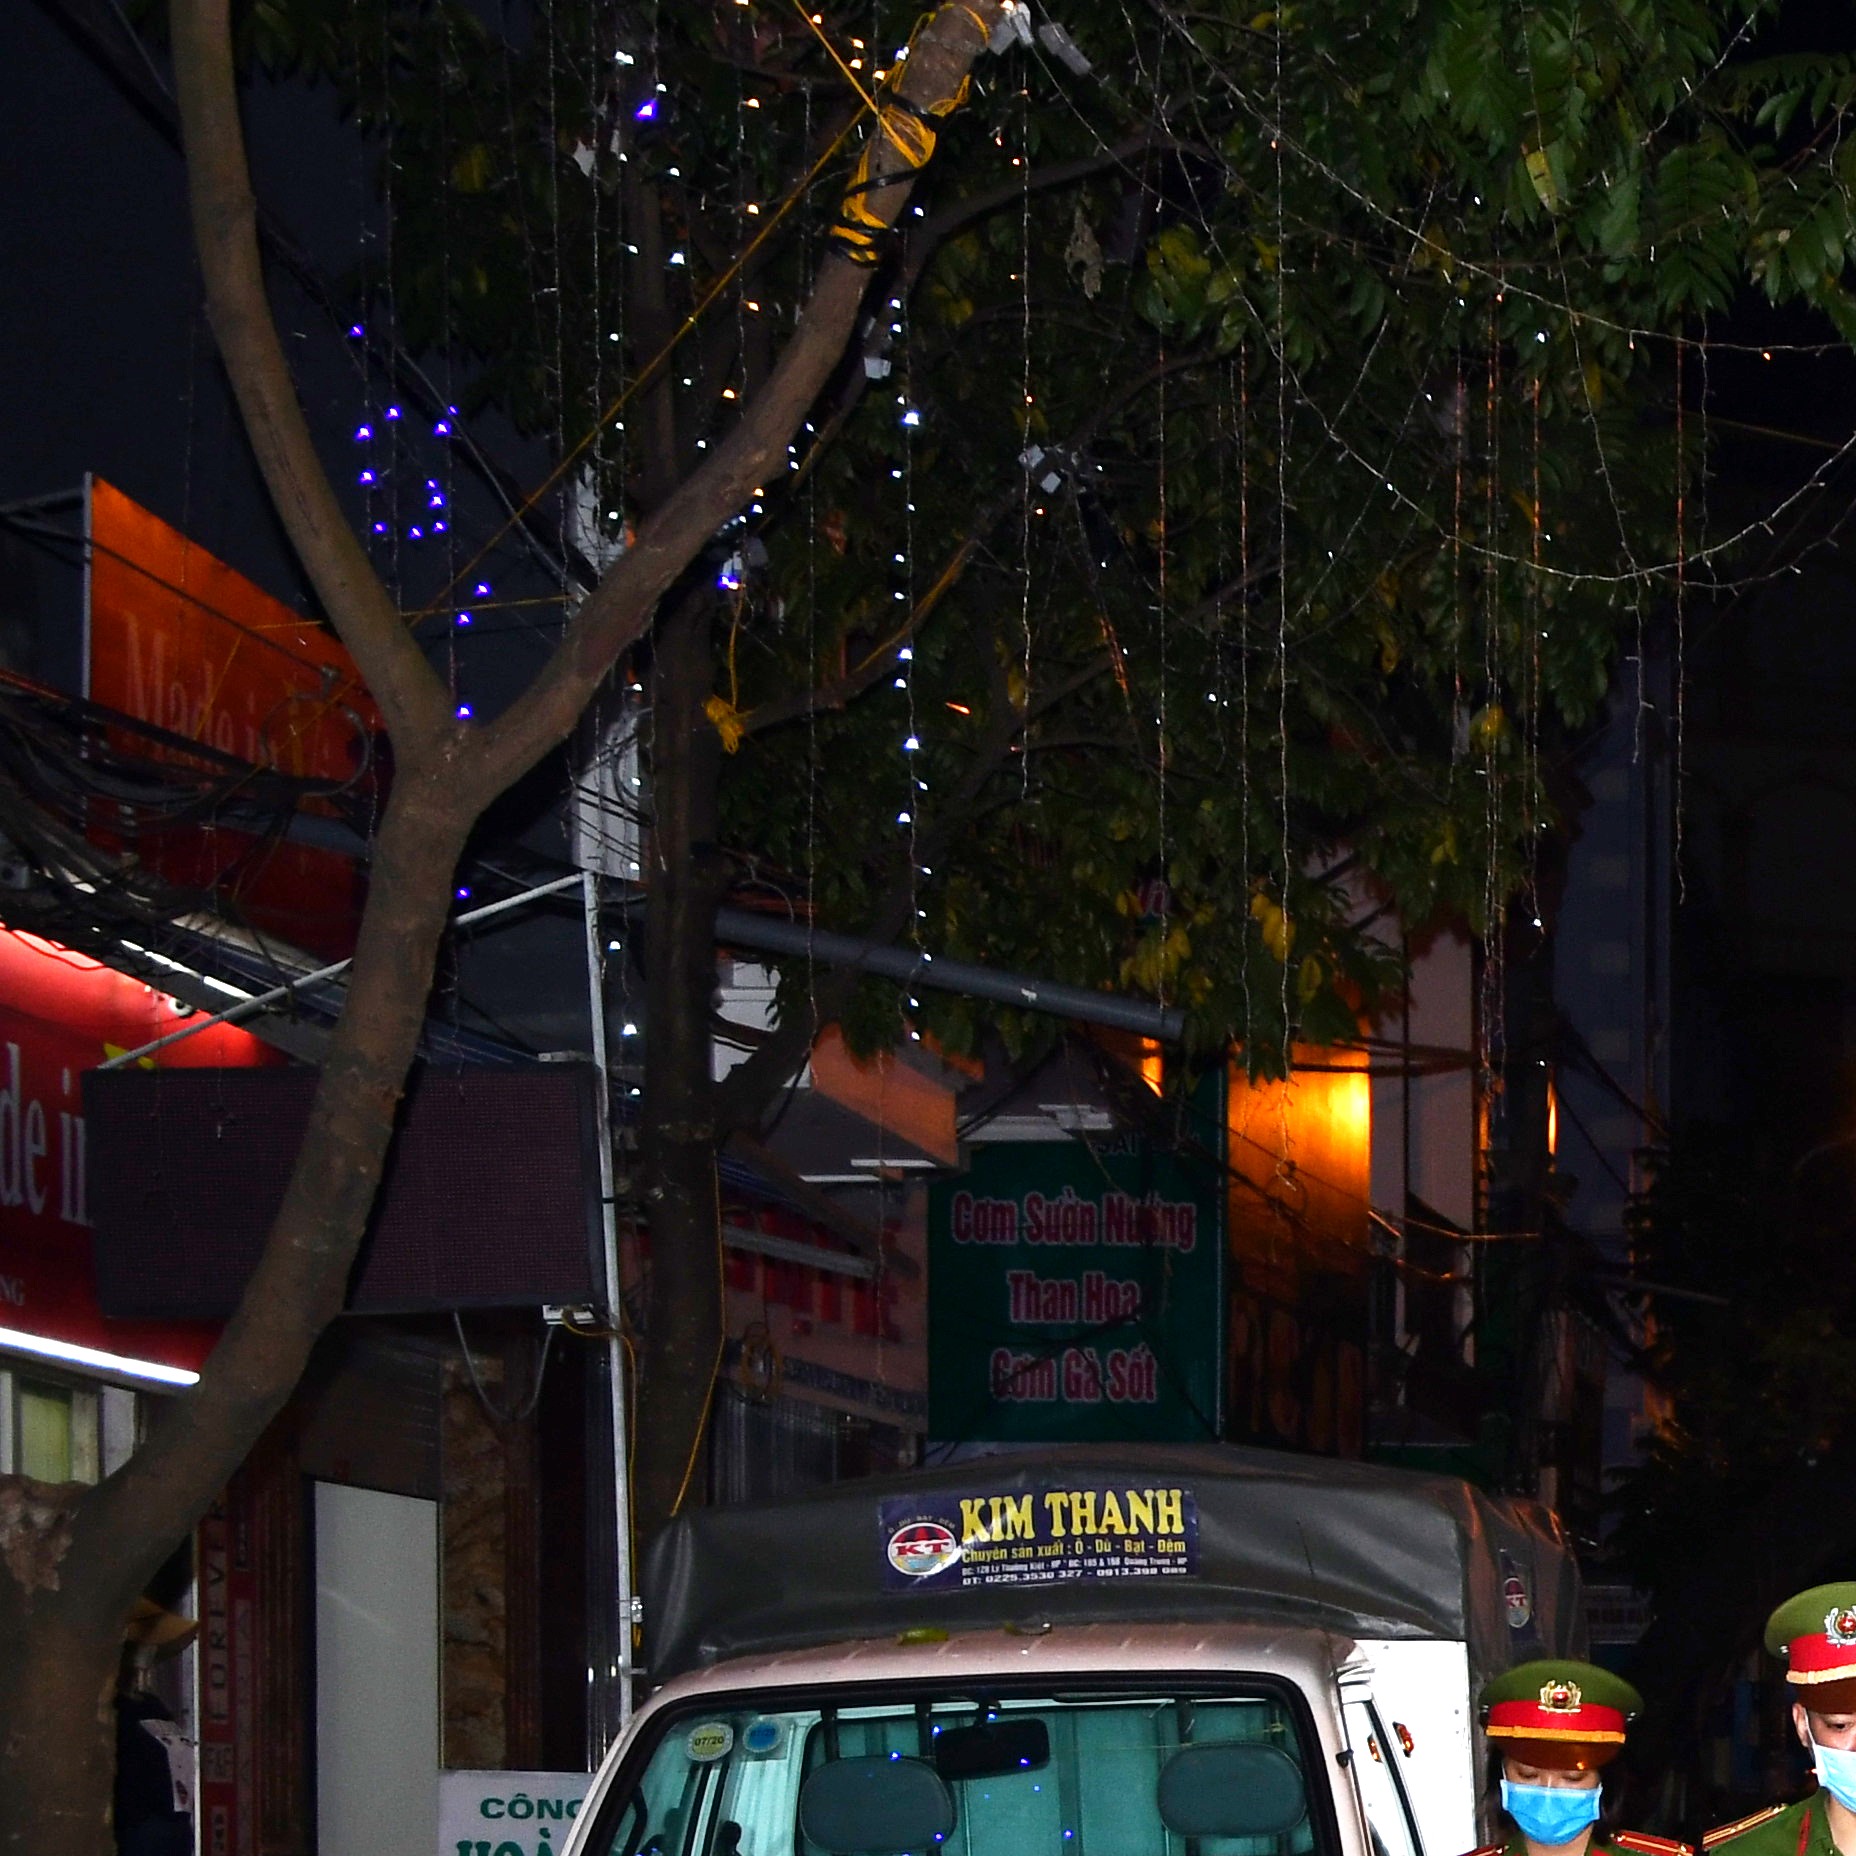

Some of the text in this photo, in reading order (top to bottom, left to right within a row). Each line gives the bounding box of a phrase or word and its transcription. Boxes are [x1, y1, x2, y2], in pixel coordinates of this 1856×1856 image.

[952, 1190, 1018, 1244] Cơm
[1024, 1185, 1099, 1246] Sườn
[1006, 1269, 1078, 1325] Than
[989, 1342, 1158, 1403] Cơm Gà Sốt
[960, 1489, 1186, 1544] KIM THANH
[896, 1542, 950, 1556] KT
[962, 1546, 1008, 1563] Chuyên
[1011, 1542, 1033, 1558] sản
[1037, 1539, 1064, 1557] xuất
[1095, 1538, 1112, 1553] Dù
[1124, 1539, 1146, 1556] Bạt
[1058, 1568, 1083, 1578] 327
[694, 1736, 725, 1747] 07/20
